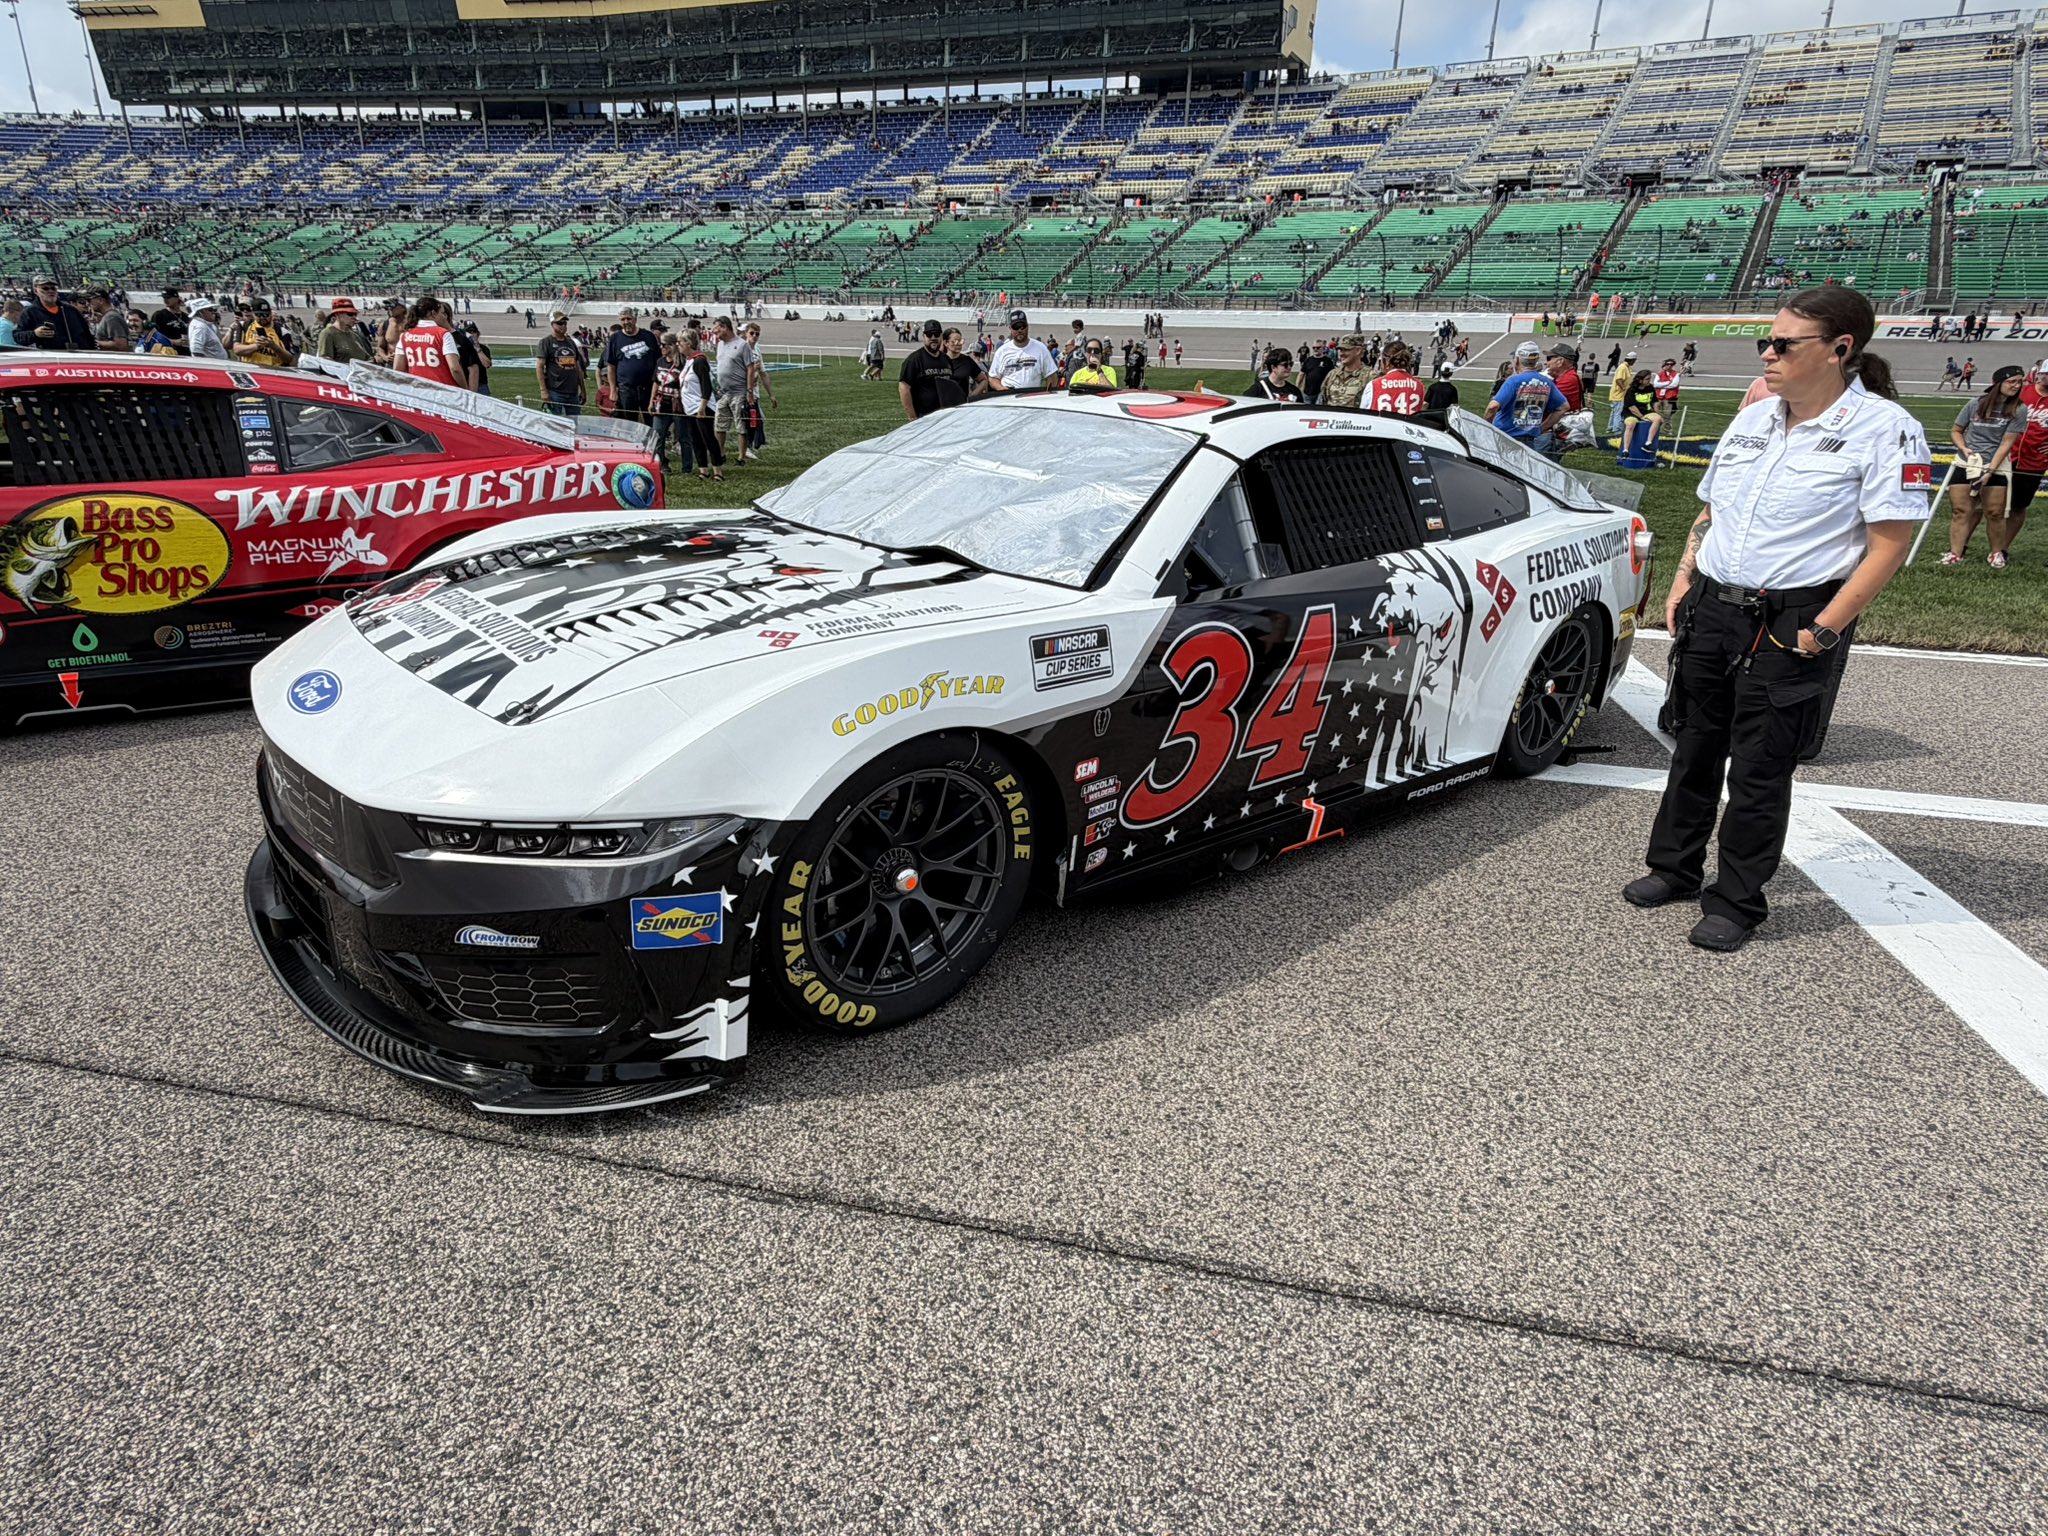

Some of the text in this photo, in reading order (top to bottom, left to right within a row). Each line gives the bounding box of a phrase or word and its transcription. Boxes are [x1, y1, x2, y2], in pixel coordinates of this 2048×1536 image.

[404, 332, 435, 345] Security
[1633, 323, 1690, 335] POET
[1711, 324, 1772, 336] POET
[405, 347, 440, 368] 616
[54, 368, 182, 381] AUSTINDILLON3
[1381, 378, 1417, 391] Security
[1377, 392, 1421, 416] 642
[255, 430, 272, 438] ptc
[214, 461, 610, 531] WINCHESTER
[81, 500, 175, 534] Bass
[91, 531, 161, 564] Pro
[247, 537, 352, 553] MAGNUM
[249, 550, 371, 566] PHEASANT
[1526, 527, 1629, 585] FEDERAL SOLUTIONS
[98, 562, 211, 601] Shops
[1481, 568, 1491, 584] F
[1501, 588, 1510, 604] S
[1529, 574, 1604, 623] COMPANY
[303, 604, 337, 616] DO
[391, 601, 461, 640] COMPANY
[805, 604, 964, 631] FEDERAL SOLUTIONS
[186, 621, 233, 632] BREZTRI
[430, 588, 491, 626] FEDERAL
[469, 604, 558, 663] SOLUTIONS
[816, 620, 896, 638] COMPANY
[1486, 615, 1495, 631] C
[1058, 632, 1099, 653] NASCAR
[47, 652, 132, 669] GET BIOETHANOL
[1046, 653, 1102, 677] CUP SERIES
[293, 675, 332, 708] Ford
[1119, 604, 1337, 830] 34
[1075, 759, 1098, 780] SEM
[1083, 778, 1115, 795] LINCOLN
[1407, 765, 1490, 801] FORD RACING
[994, 773, 1032, 861] EAGLE
[638, 912, 718, 931] SUNOCO
